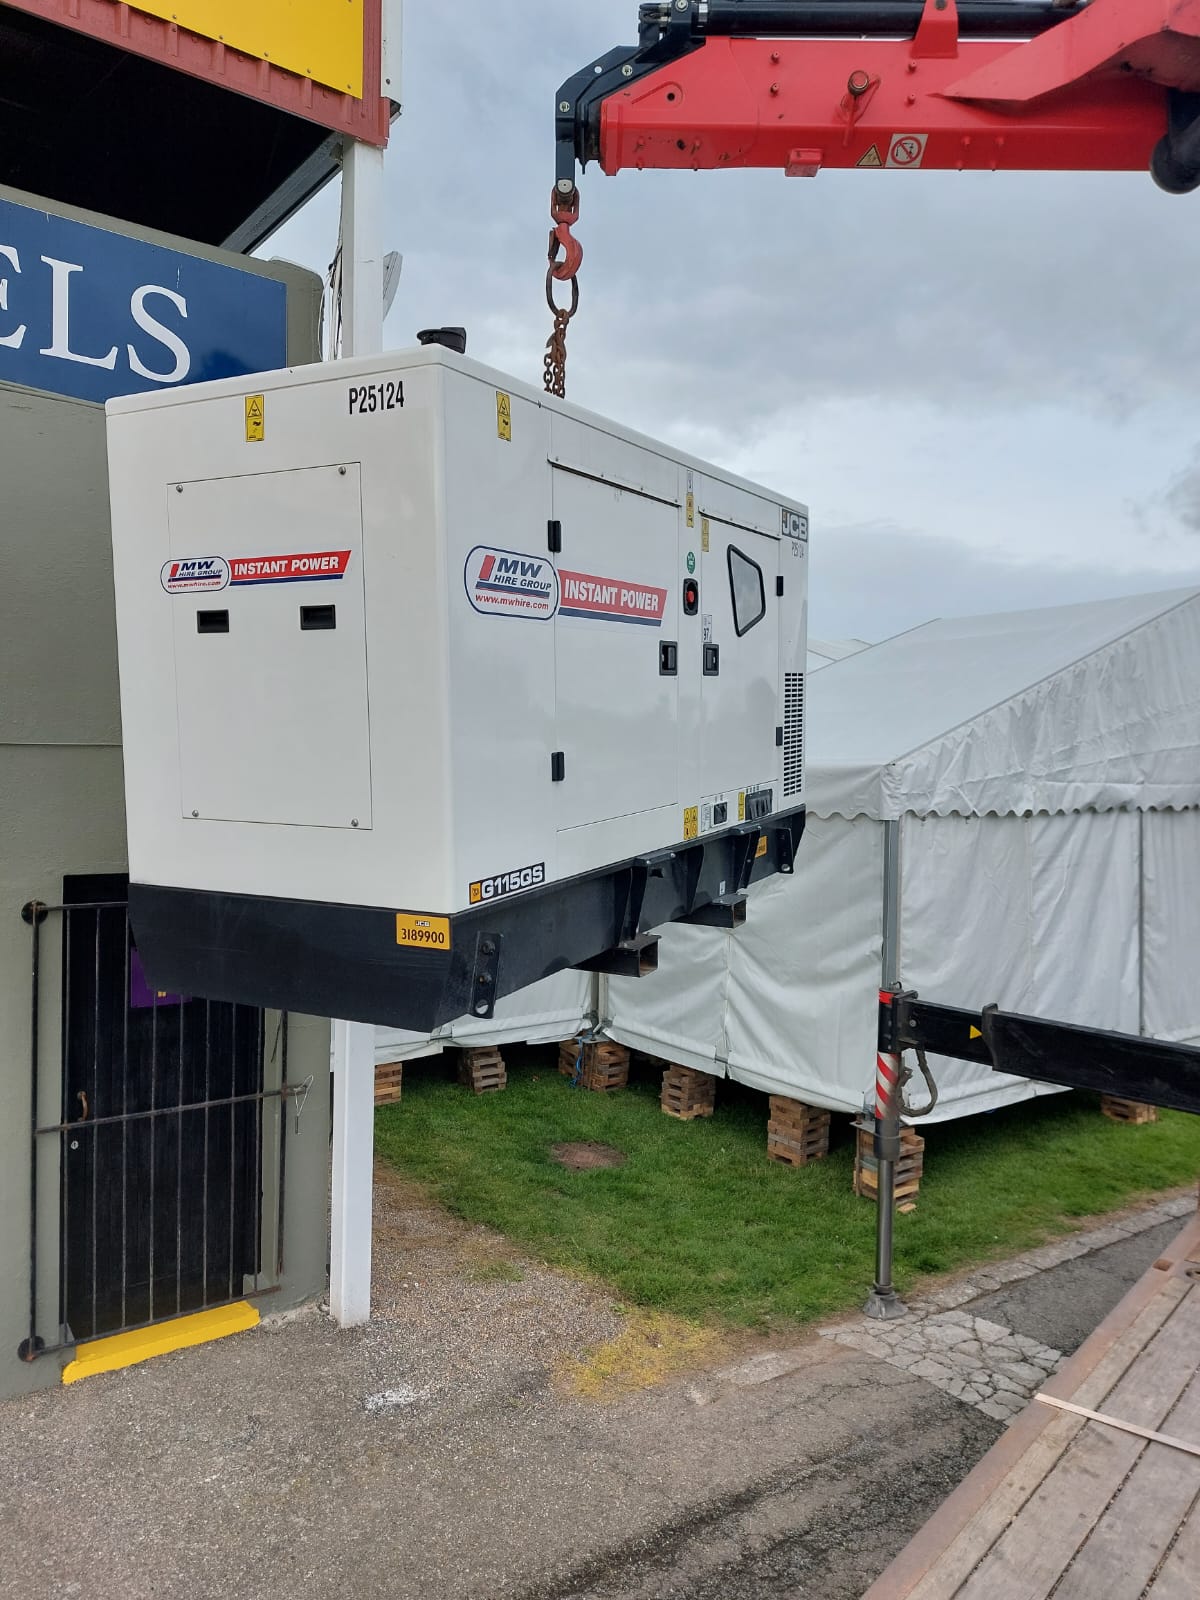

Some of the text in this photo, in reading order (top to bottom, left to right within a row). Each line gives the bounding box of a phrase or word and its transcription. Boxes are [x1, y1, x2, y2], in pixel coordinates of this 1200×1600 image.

[349, 380, 405, 415] P25124
[782, 510, 807, 541] JCB
[180, 560, 215, 572] MW
[234, 556, 339, 576] INSTANT POWER
[496, 557, 543, 579] MW
[493, 574, 552, 591] HIRE GROUP
[475, 594, 549, 610] www.mwhire.com
[564, 578, 659, 612] INSTANT POWER
[481, 864, 543, 899] G115QS
[401, 928, 445, 944] 3189900
